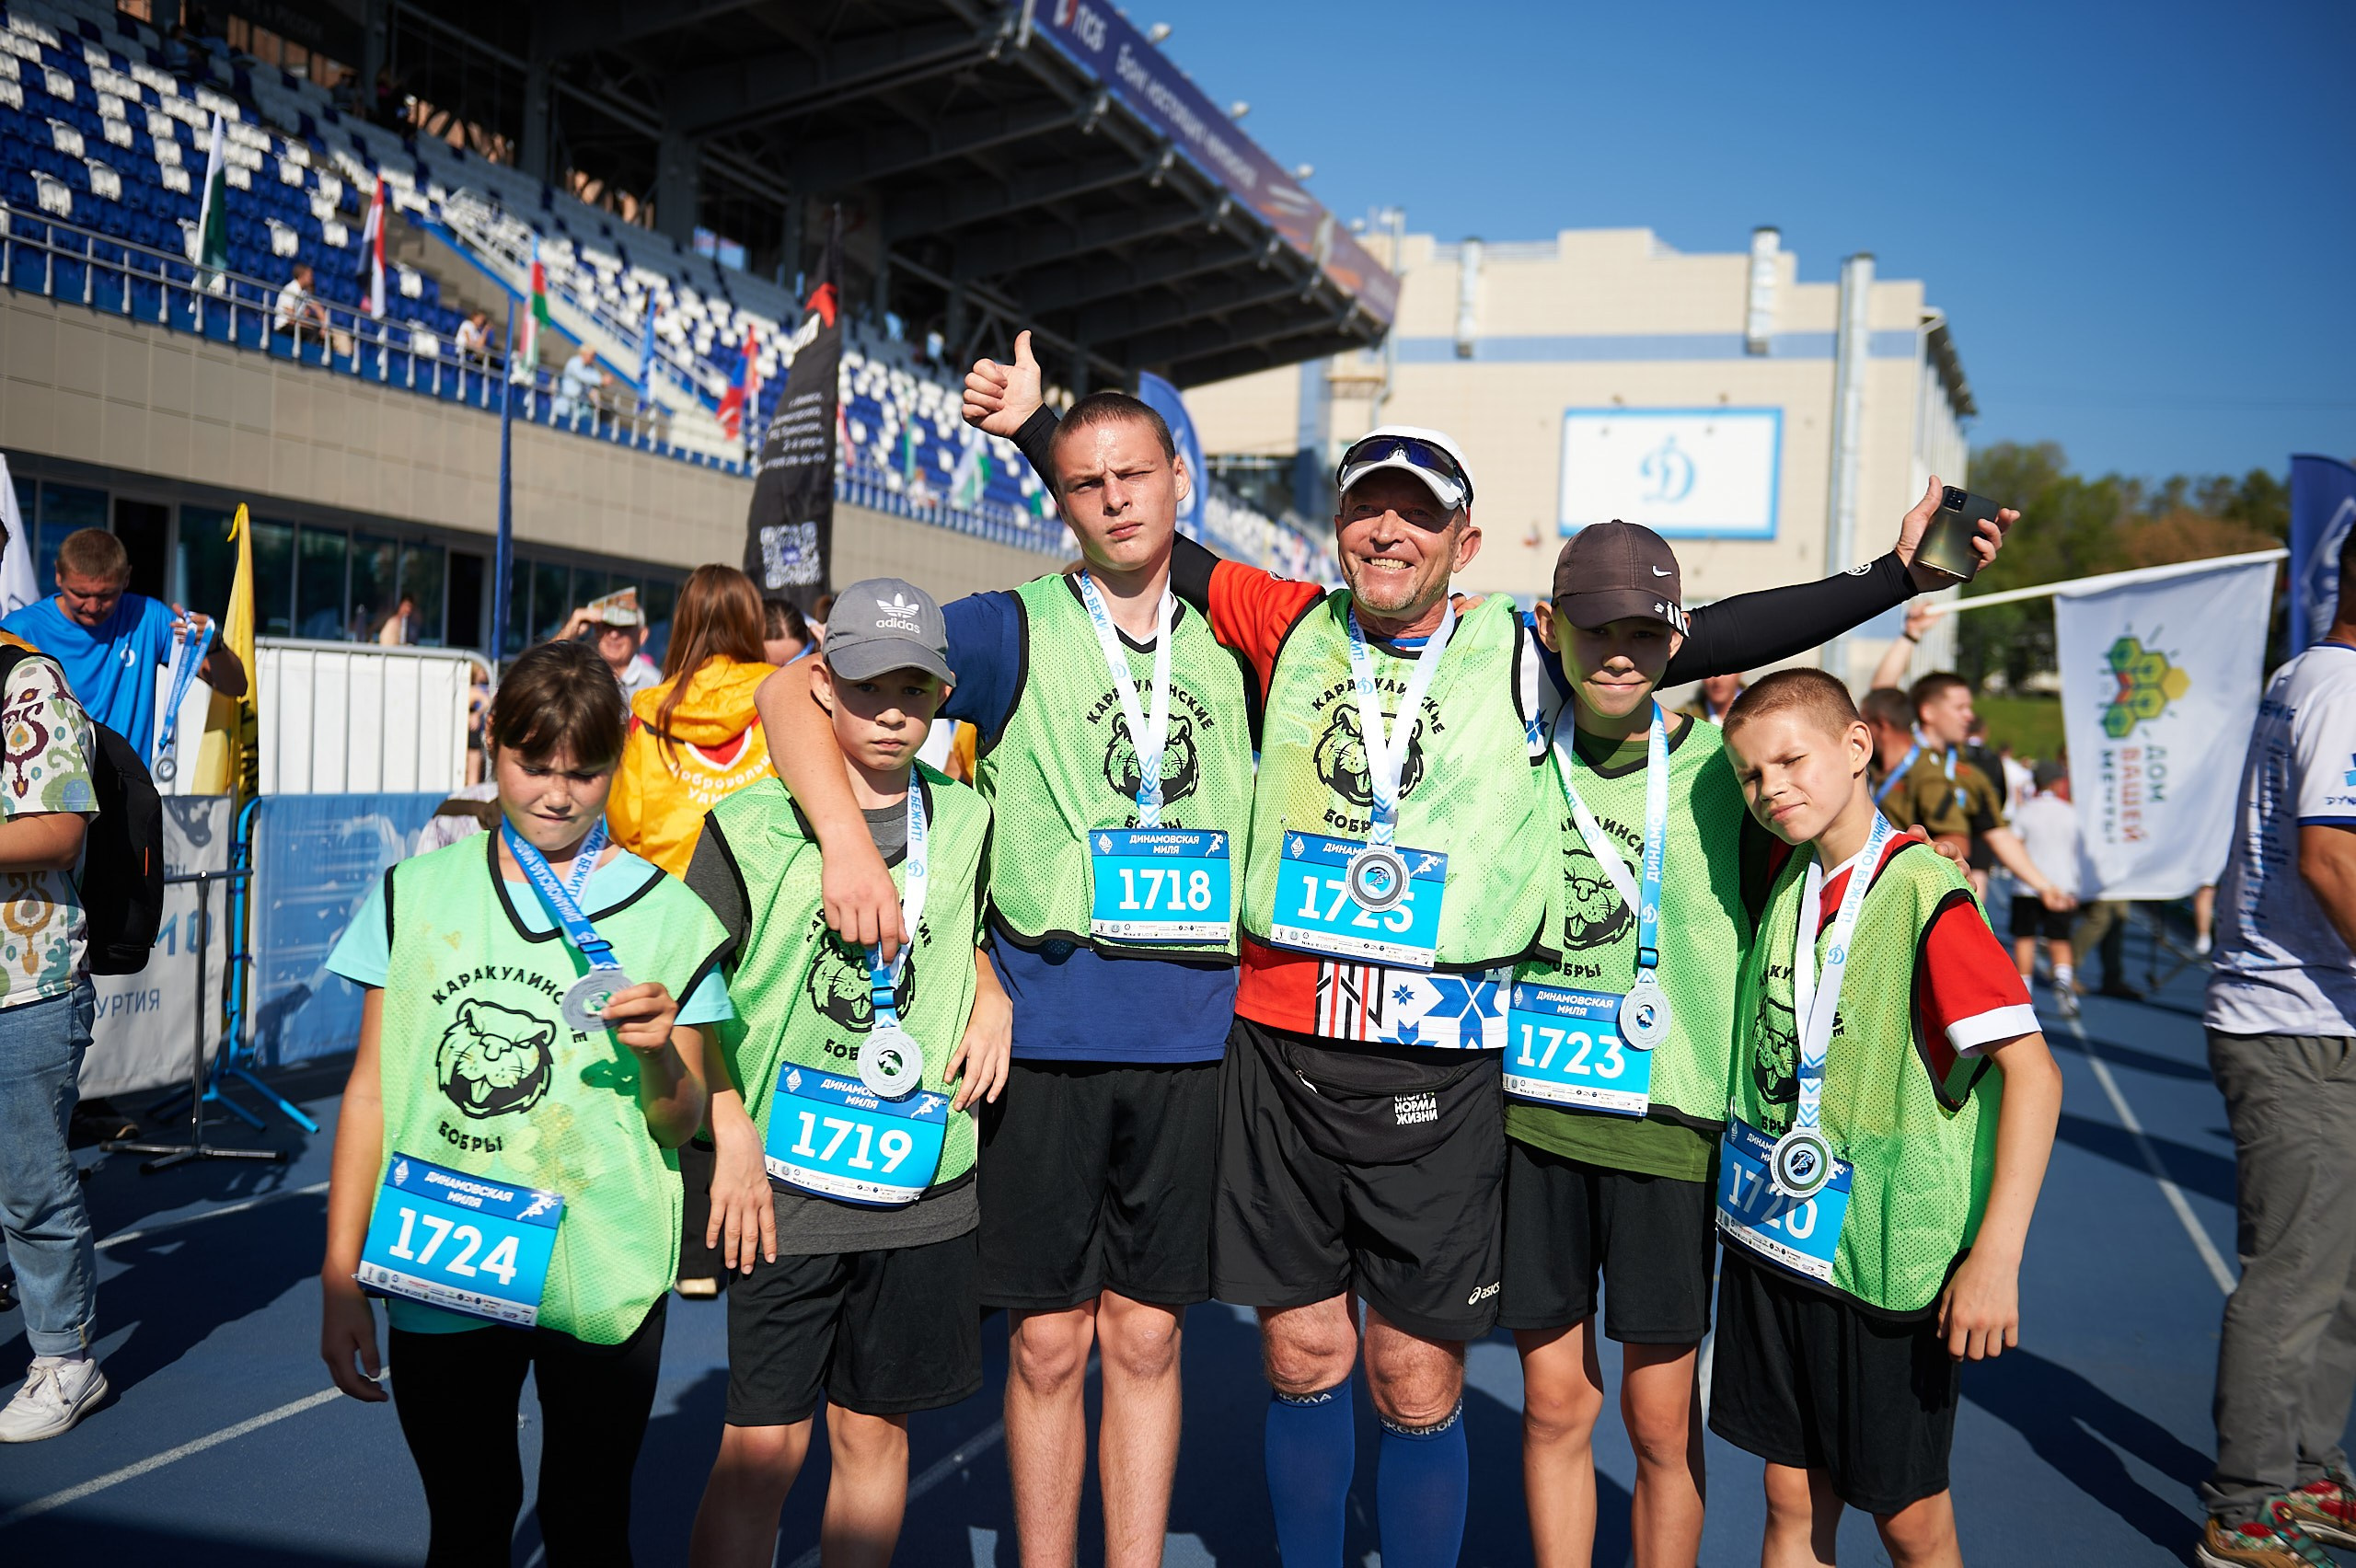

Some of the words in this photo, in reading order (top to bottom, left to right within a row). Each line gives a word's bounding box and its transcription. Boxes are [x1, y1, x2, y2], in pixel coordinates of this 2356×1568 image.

[875, 617, 921, 634] adidas
[2144, 744, 2167, 803] ДОМ
[2120, 746, 2149, 844] ВАШЕЙ
[910, 793, 923, 842] БЕЖИТ!
[1322, 808, 1371, 834] БОБР
[1129, 835, 1200, 845] ДИНАМОВСКАЯ
[1152, 845, 1180, 854] МИЛЯ
[1862, 813, 1889, 866] ДИНАМО
[528, 863, 586, 923] ДИНАМОВСКАЯ
[1118, 868, 1212, 912] 1718
[1841, 870, 1869, 923] БЕЖИТ!
[432, 965, 589, 1044] КАРАКУЛИНСЕ
[1536, 990, 1614, 1009] ДИНАМОВСКАЯ
[1556, 1004, 1588, 1017] МИЛЯ
[824, 1038, 859, 1061] БОБ
[1517, 1023, 1625, 1079] 1723
[844, 1095, 879, 1110] МИЛЯ
[1394, 1097, 1438, 1114] НОРМА
[1395, 1108, 1438, 1125] ЖИЗНИ
[438, 1120, 502, 1153] БОБРЫ
[791, 1111, 913, 1173] 1719
[424, 1170, 514, 1203] ДИНАМОВСКАЯ
[446, 1191, 483, 1208] МИЛЯ
[1728, 1161, 1819, 1239] 1720
[388, 1206, 520, 1286] 1724
[1480, 1281, 1500, 1299] asics
